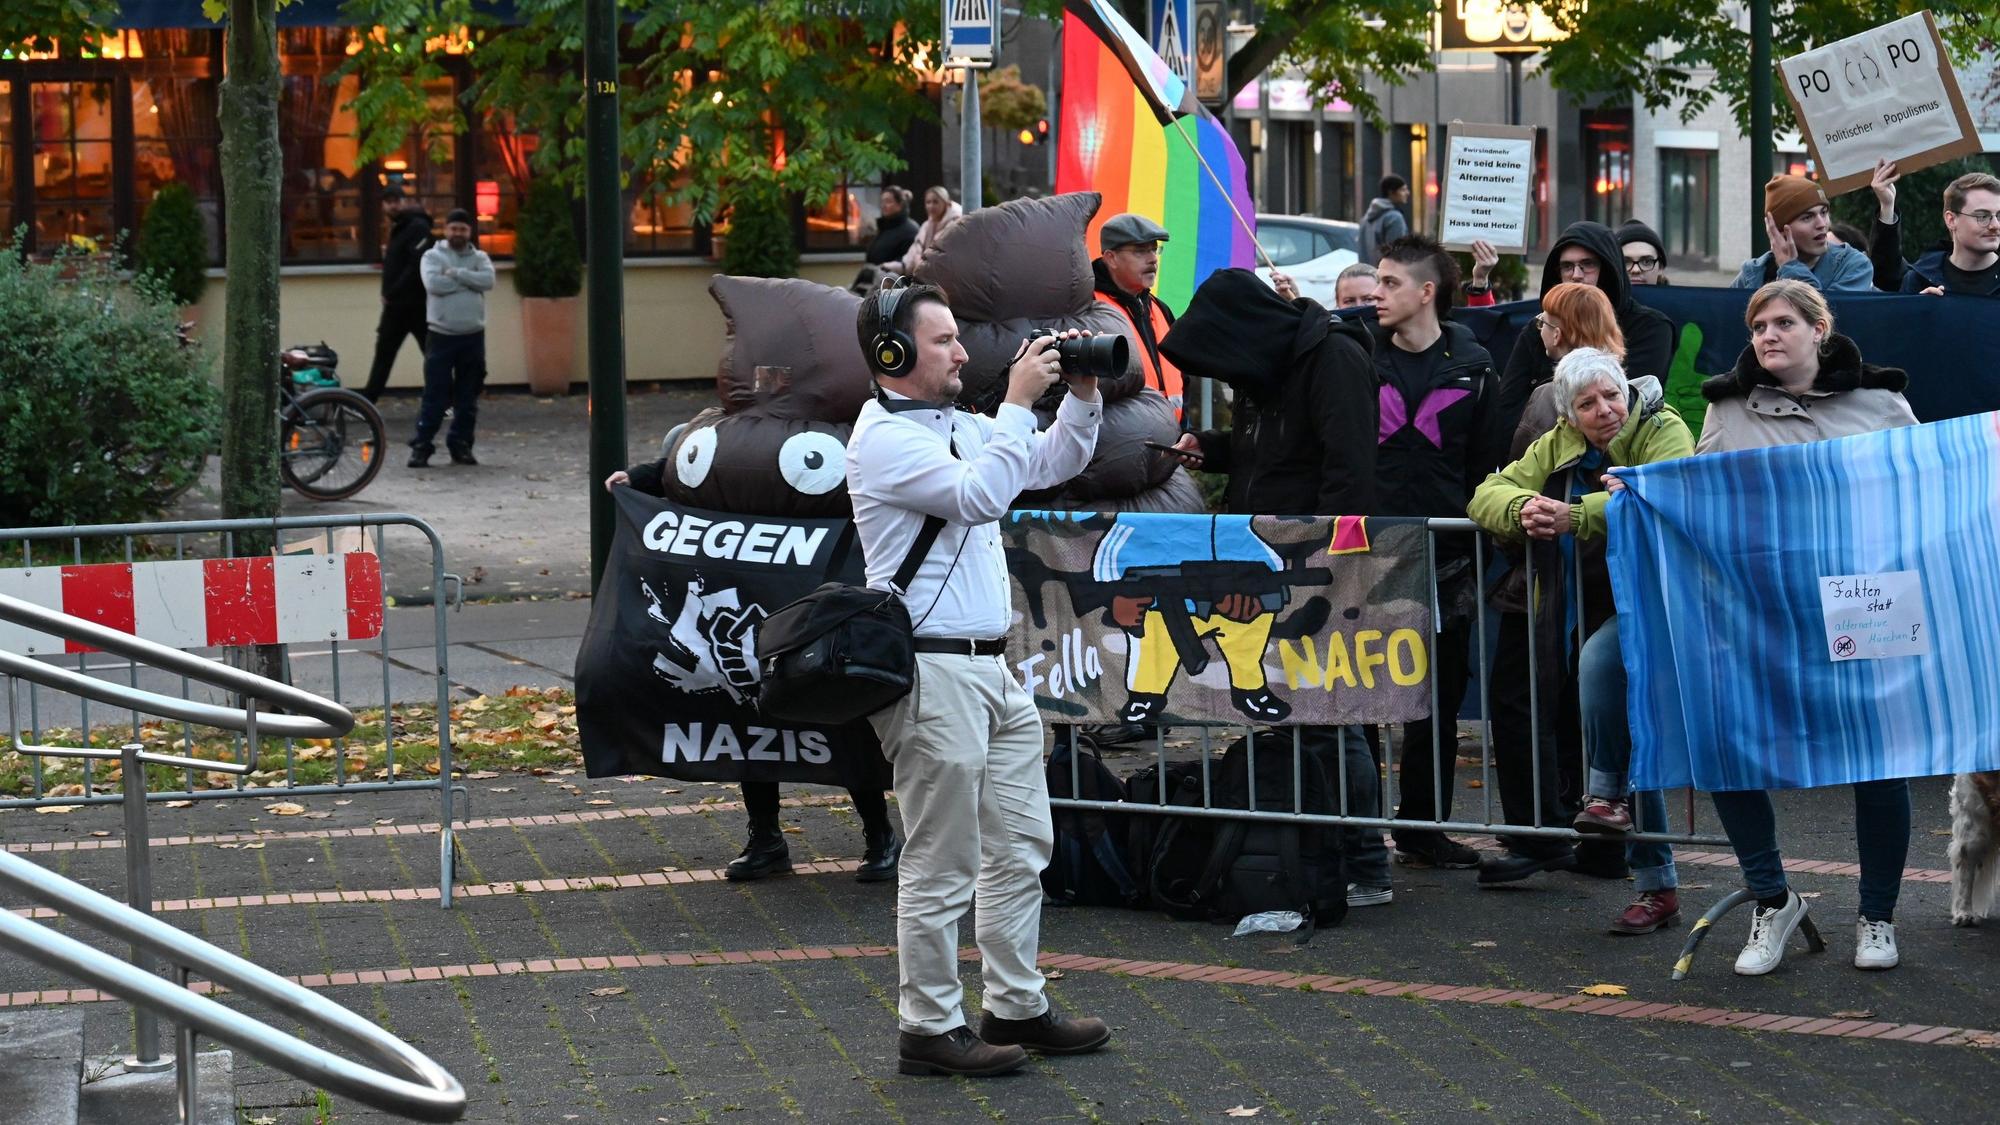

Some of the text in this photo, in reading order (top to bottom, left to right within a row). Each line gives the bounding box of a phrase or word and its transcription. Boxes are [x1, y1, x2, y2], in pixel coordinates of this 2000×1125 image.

[1798, 38, 1920, 98] PO PO
[597, 81, 616, 93] 13A
[1825, 99, 1940, 144] Politischer Populismus
[1458, 158, 1521, 169] Ihr seid keine
[1459, 173, 1515, 183] Alternative!
[1462, 194, 1506, 203] Solidarität
[1471, 208, 1492, 216] statt
[1449, 219, 1517, 230] Hass und Hetze!
[643, 510, 829, 566] GEGEN
[1829, 579, 1881, 598] Fakten
[1866, 598, 1894, 613] statt
[1834, 618, 1888, 631] alternative
[1017, 627, 1428, 700] Fella NAFO
[661, 722, 832, 764] NAZIS
